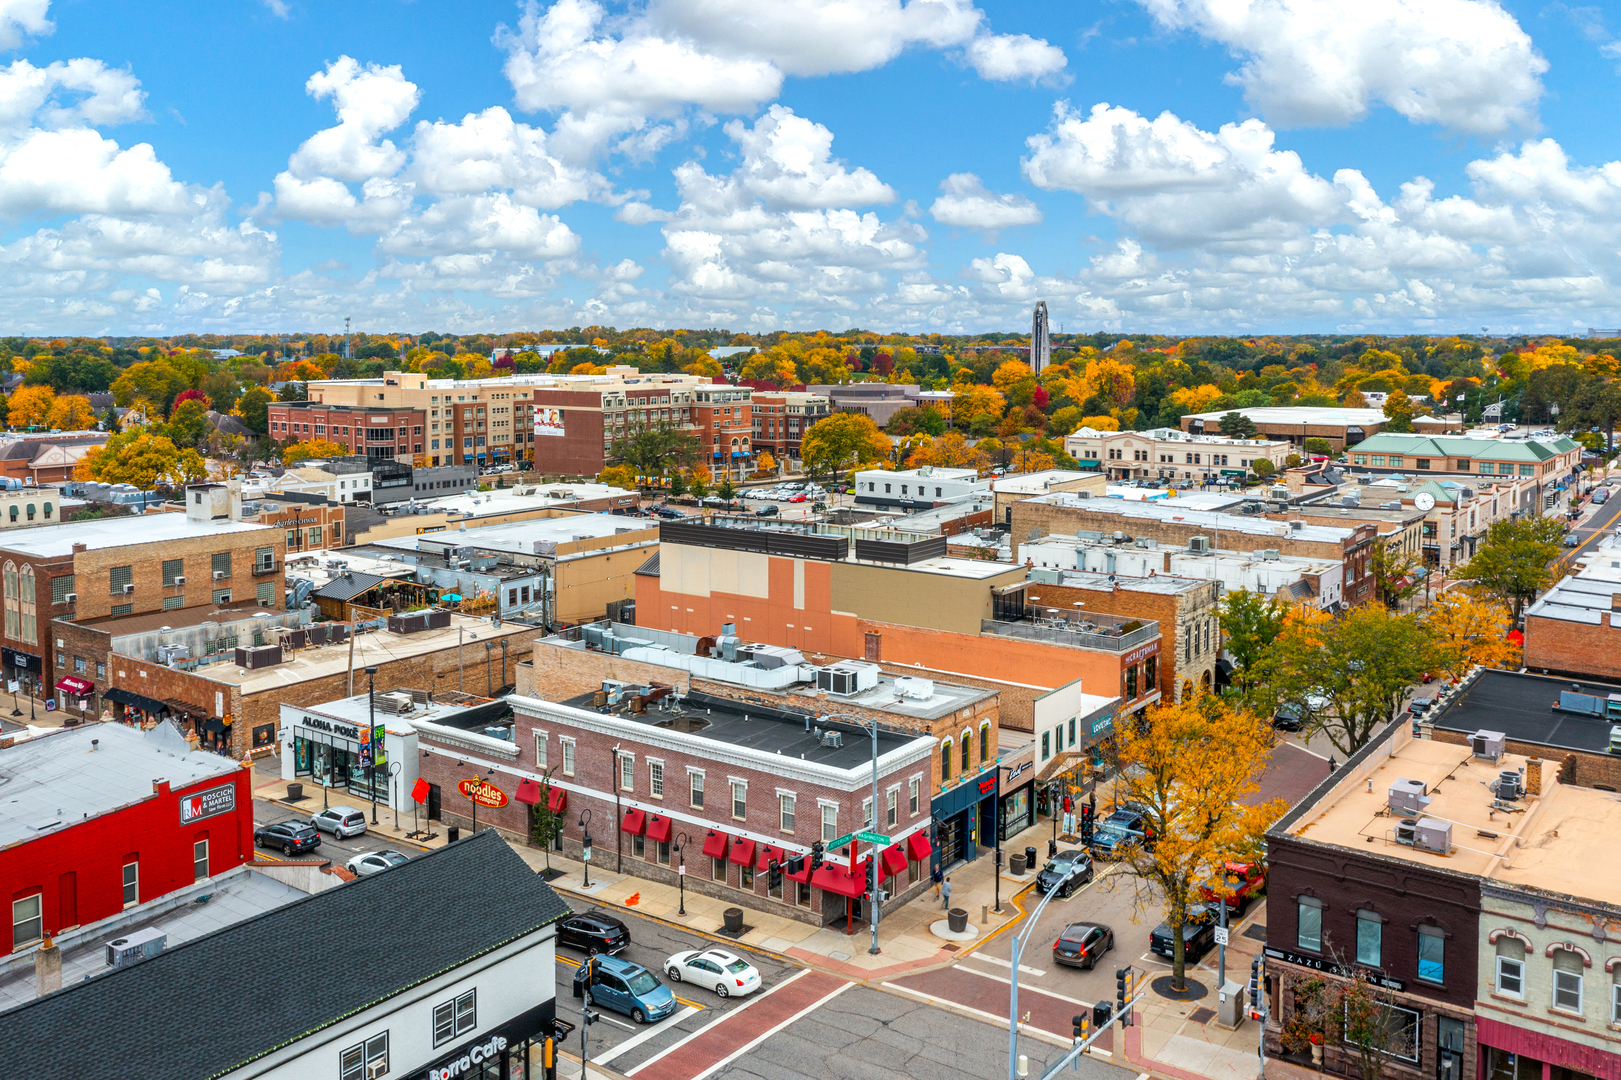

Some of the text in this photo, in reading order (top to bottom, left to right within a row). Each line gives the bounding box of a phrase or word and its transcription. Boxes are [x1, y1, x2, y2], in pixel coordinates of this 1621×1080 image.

[1130, 642, 1158, 661] CRAFTSMAN
[302, 716, 332, 732] ALOHA
[202, 788, 232, 802] ROSCICH
[464, 782, 502, 801] noodles
[208, 795, 232, 807] MARTEL
[478, 796, 500, 807] company
[830, 836, 850, 848] JEFFERSON
[858, 833, 884, 842] WASHINGTON
[1216, 935, 1226, 943] 25
[1288, 954, 1322, 968] ZAZÚ
[429, 1056, 470, 1080] Borra
